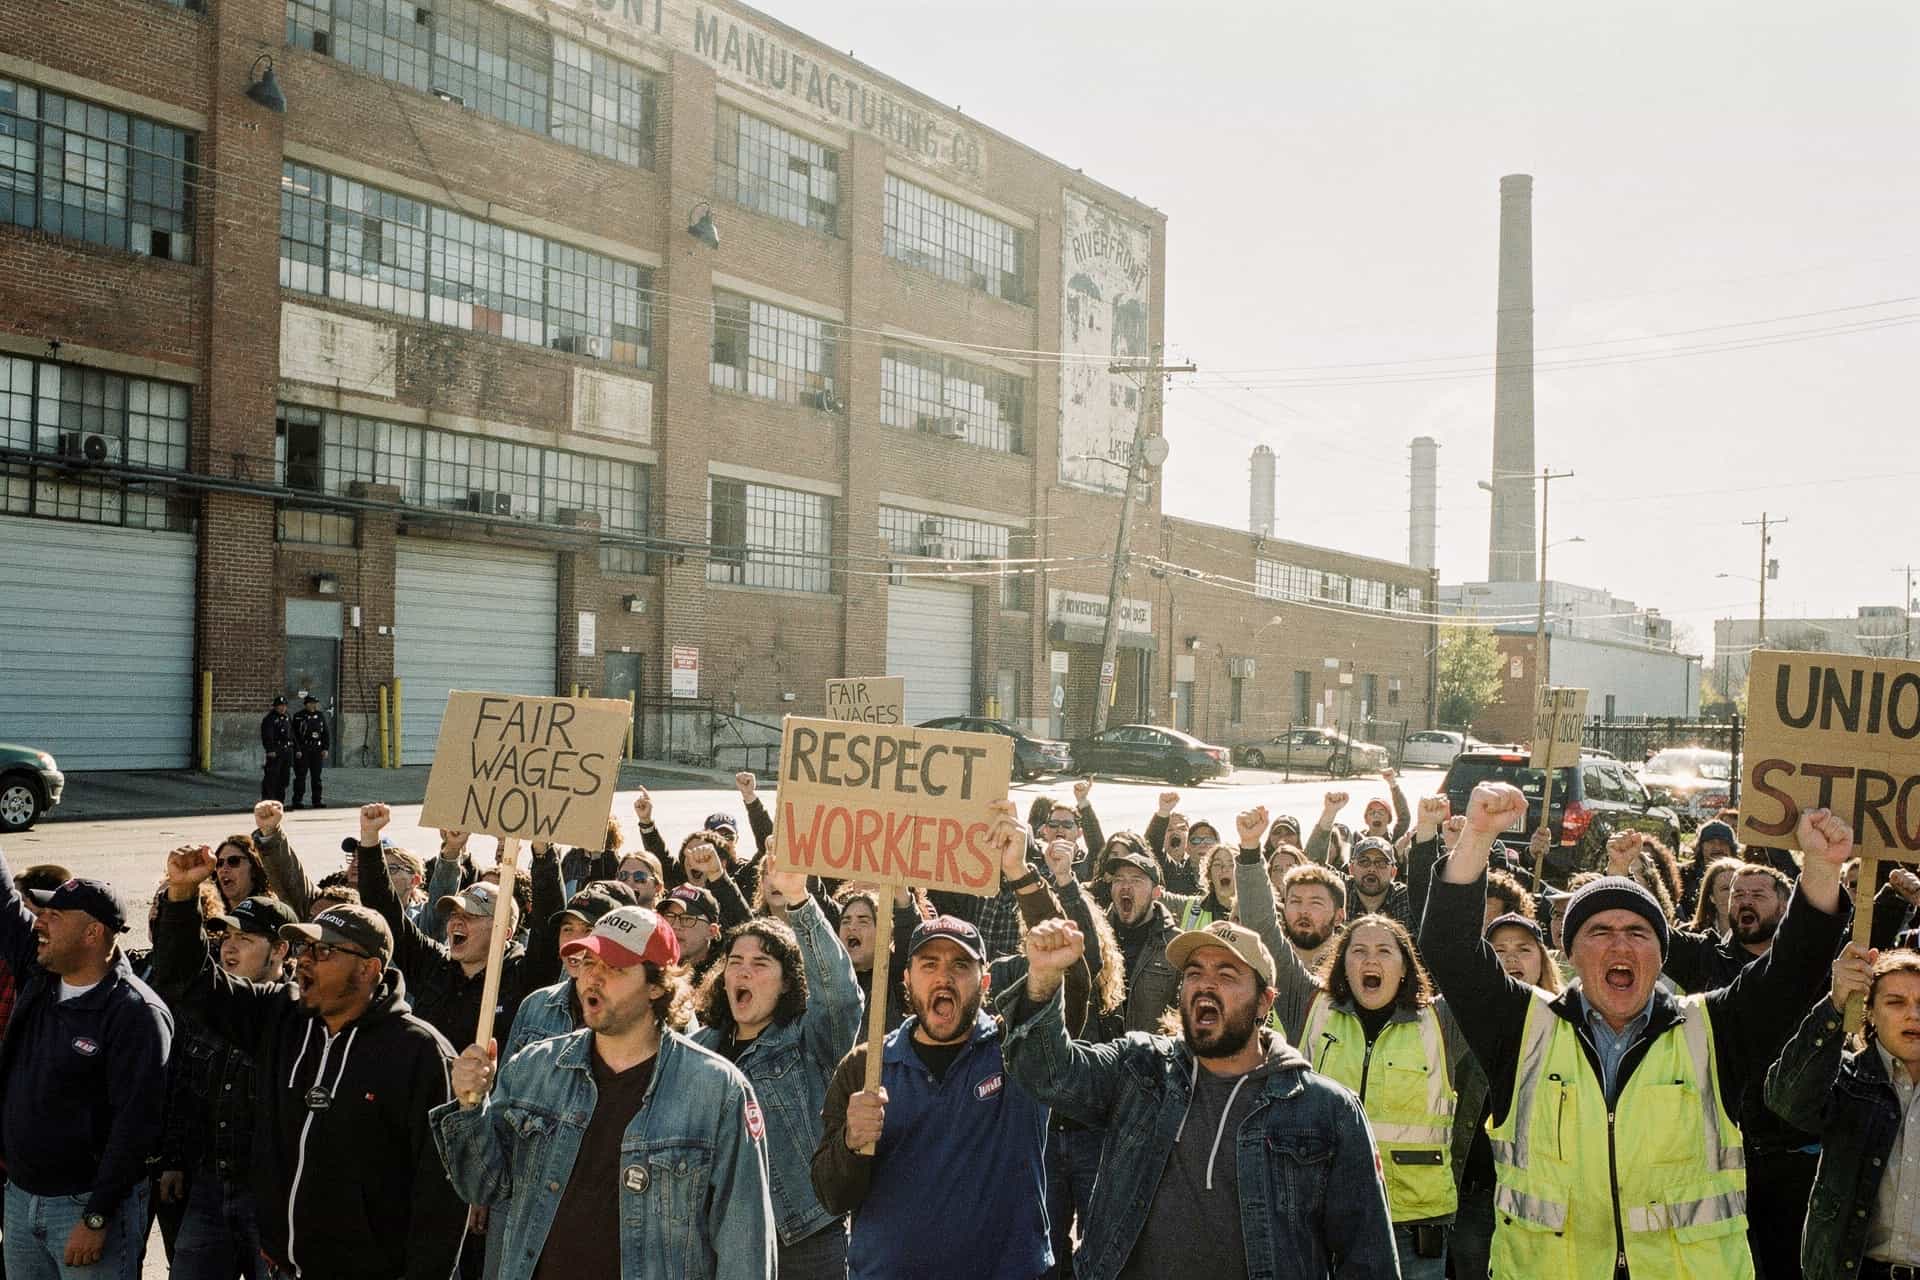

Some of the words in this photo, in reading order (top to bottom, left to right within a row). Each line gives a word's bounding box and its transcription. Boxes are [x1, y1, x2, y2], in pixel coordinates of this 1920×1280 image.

[694, 7, 938, 161] MANUFACTURING
[1072, 230, 1146, 294] RIVERFRONT
[473, 697, 576, 749] FAIR
[829, 682, 871, 705] FAIR
[832, 704, 899, 725] WAGES
[1775, 664, 1920, 739] UNIO
[471, 741, 605, 796] WAGES
[788, 727, 987, 800] RESPECT
[460, 784, 571, 837] NOW
[785, 801, 993, 889] WORKERS
